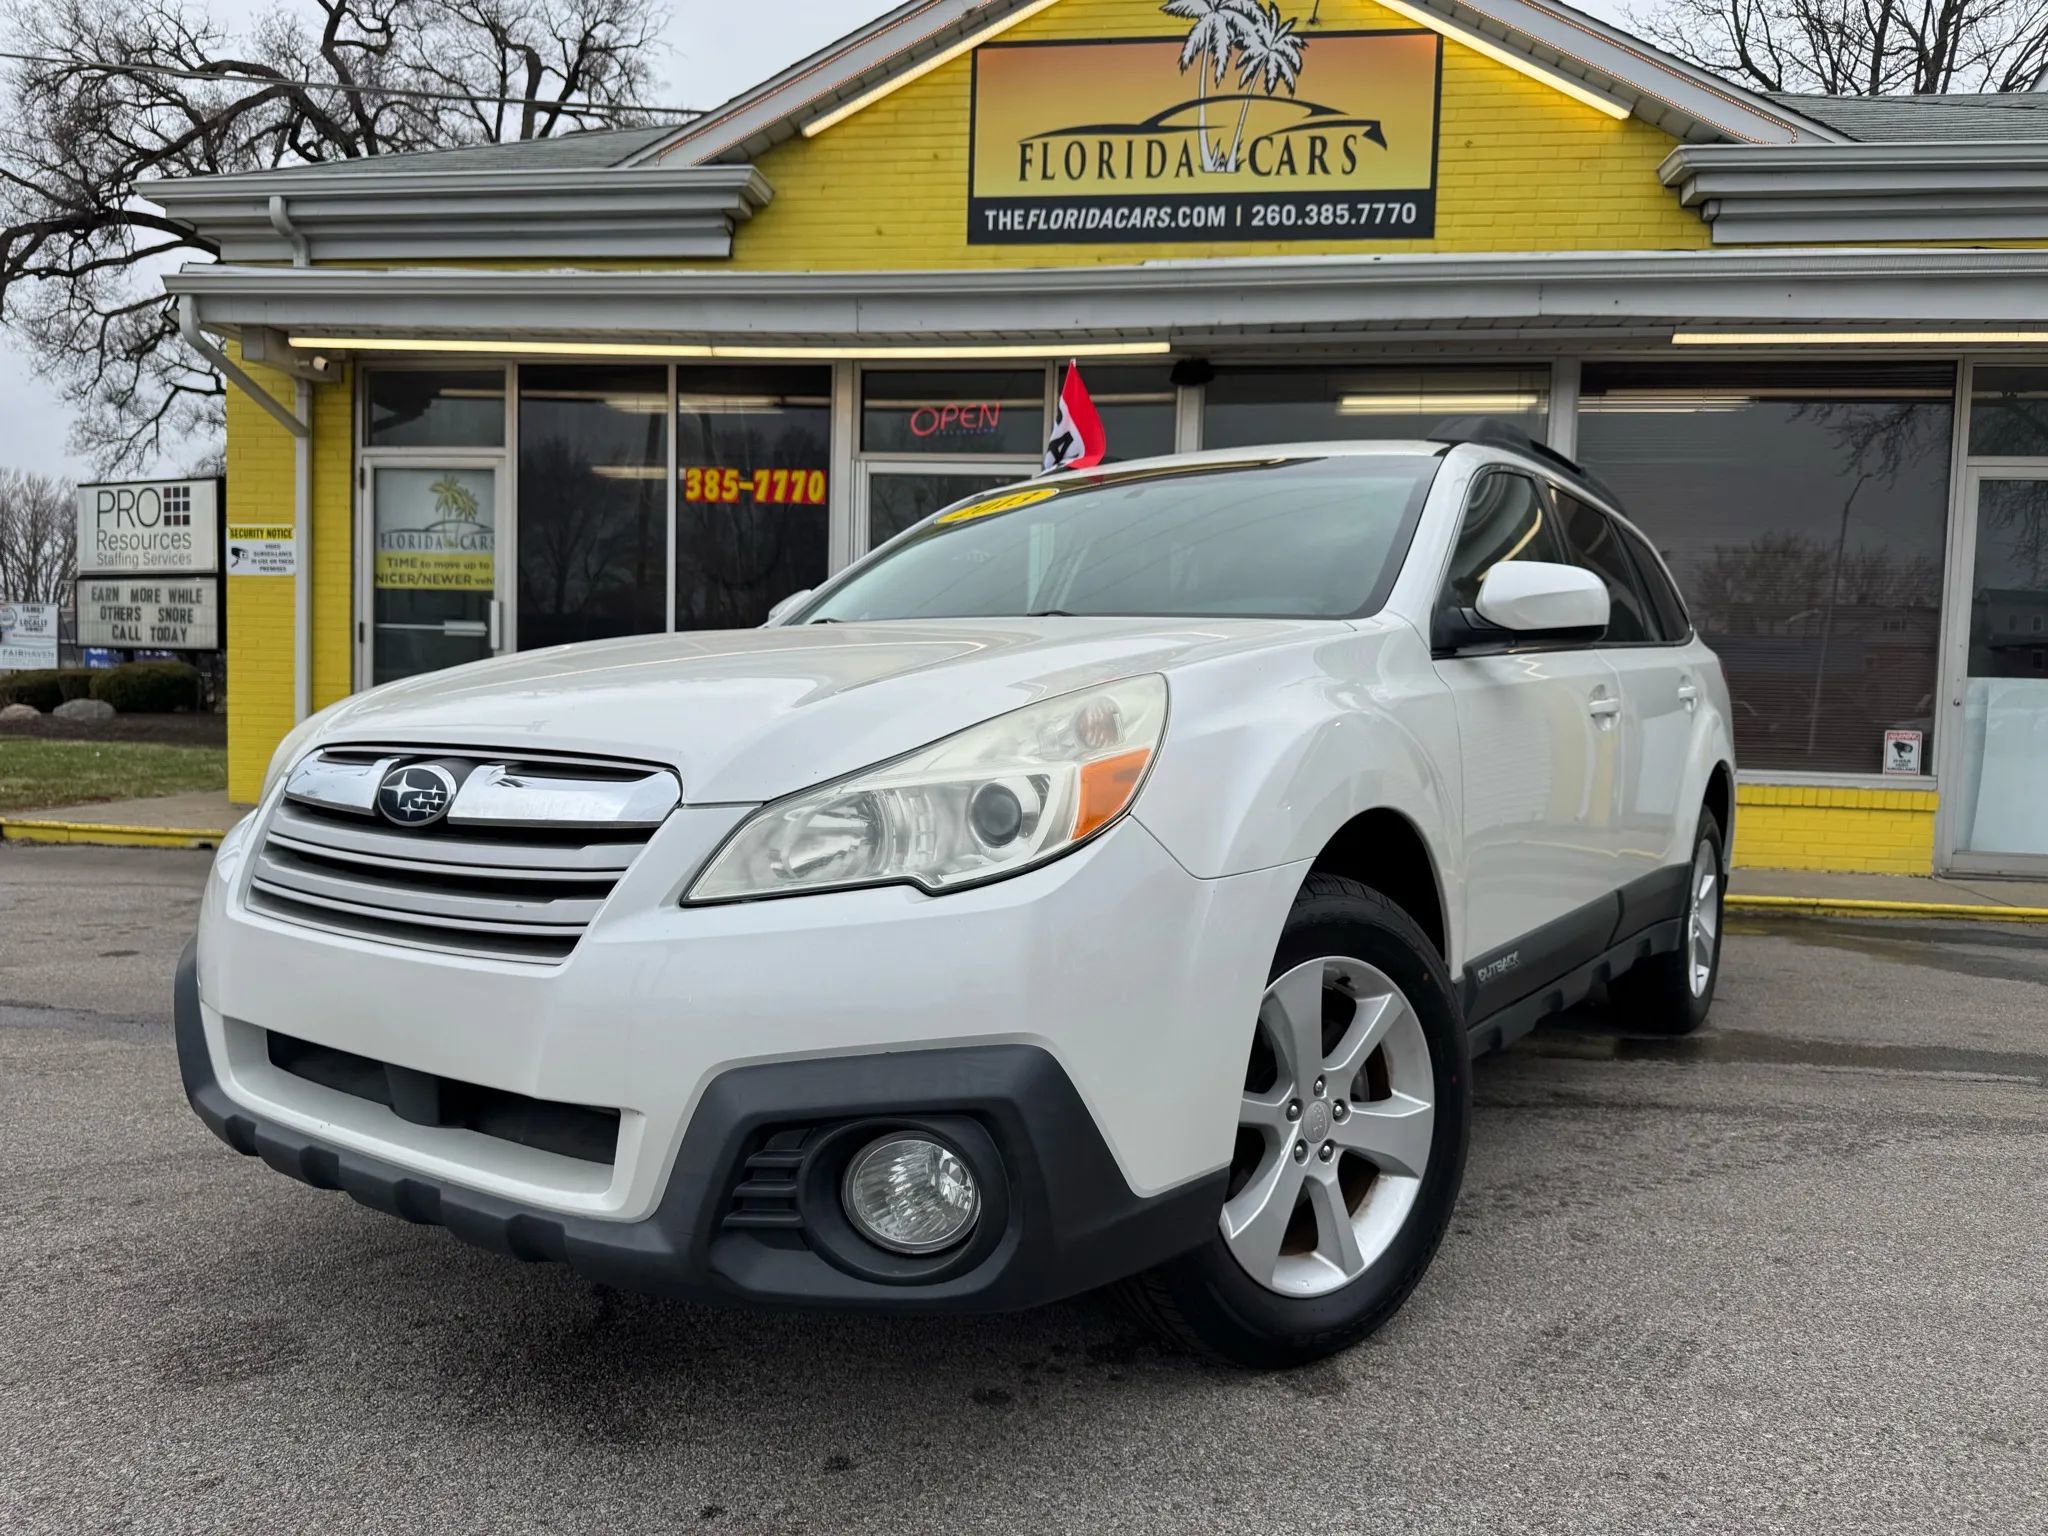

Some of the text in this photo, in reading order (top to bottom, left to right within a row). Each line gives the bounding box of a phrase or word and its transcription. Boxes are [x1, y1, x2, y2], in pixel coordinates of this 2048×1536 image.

[1018, 134, 1357, 182] FLORIDA CARS
[984, 203, 1417, 231] THEFLORIDACARS.COM 260.385.7770
[910, 401, 1001, 436] OPEN
[685, 467, 826, 503] 385-7770
[97, 487, 161, 528] PRO
[97, 529, 192, 551] Resources
[230, 528, 292, 539] SECURITY NOTICE
[380, 532, 443, 550] FLORIDA
[97, 550, 192, 569] Staffing Services
[386, 557, 418, 569] TIME
[420, 561, 431, 569] to
[463, 562, 478, 570] up
[479, 561, 490, 570] to
[374, 572, 472, 585] NICER/NEWER
[91, 586, 203, 605] EARN MORE WHILE
[100, 605, 194, 624] OTHERS SNORE
[111, 625, 188, 643] CALL TODAY
[1477, 951, 1521, 982] OUTBACK
